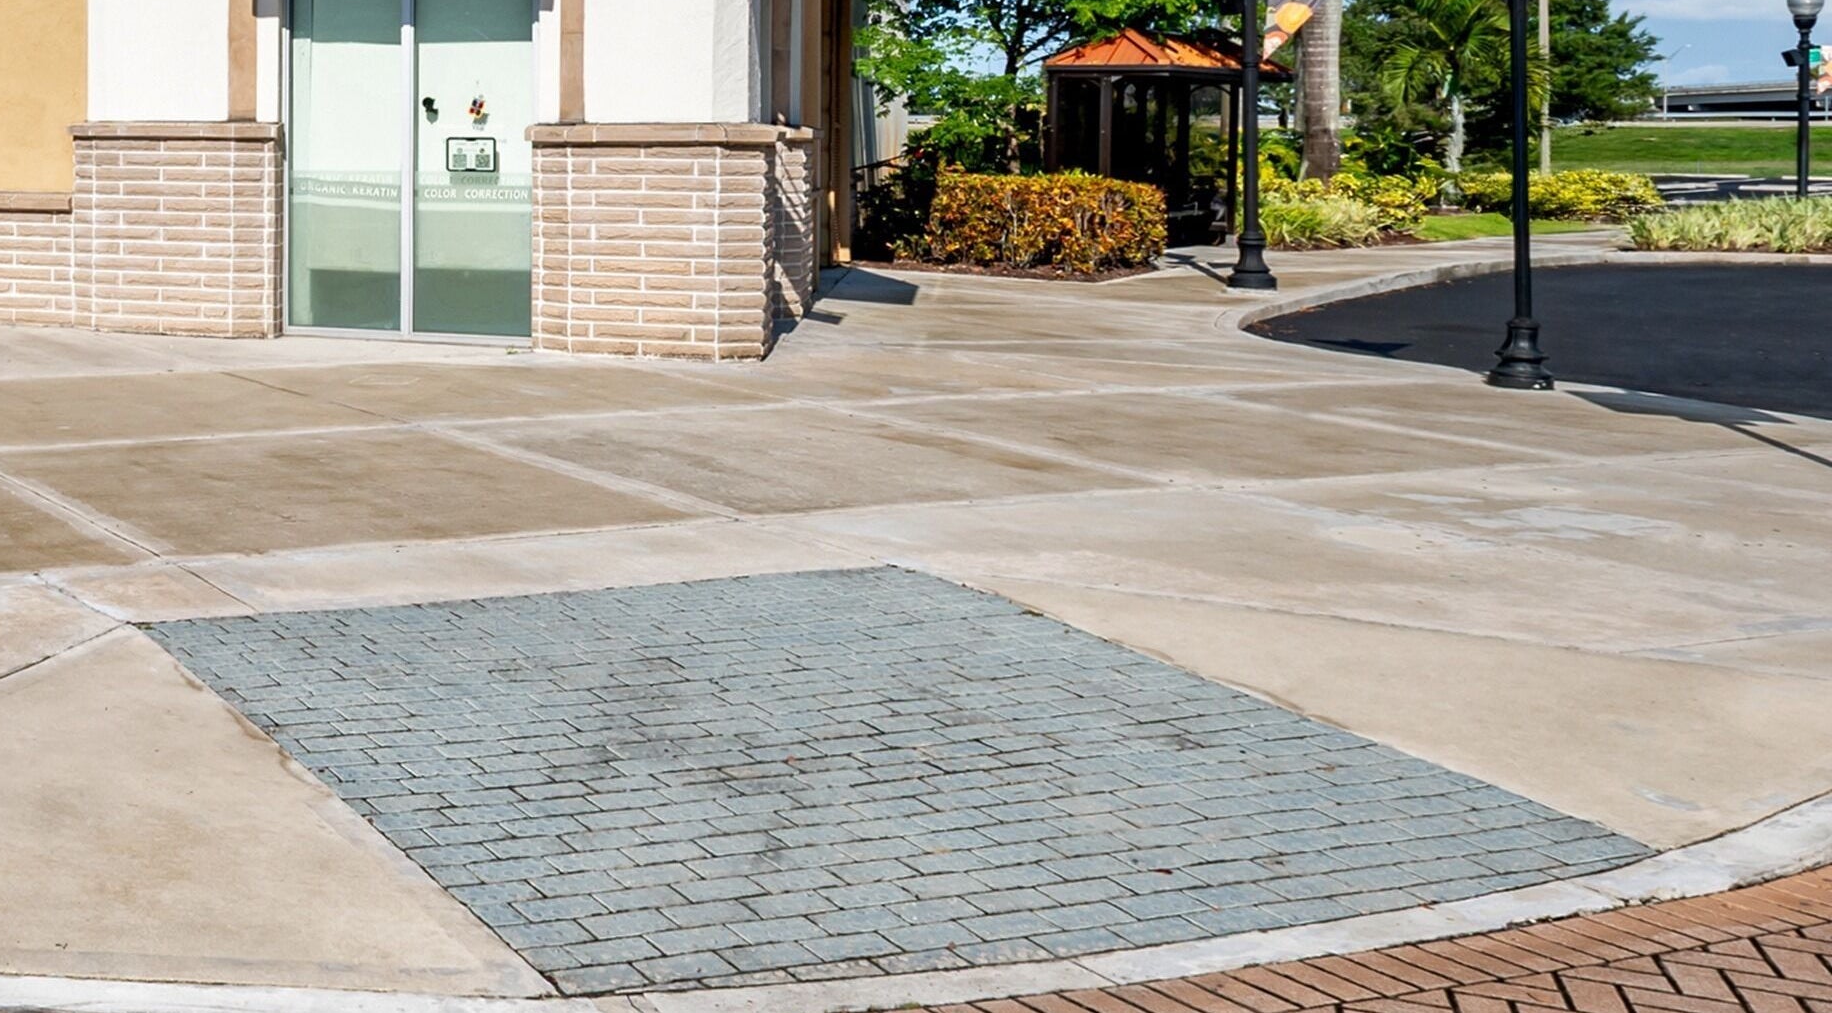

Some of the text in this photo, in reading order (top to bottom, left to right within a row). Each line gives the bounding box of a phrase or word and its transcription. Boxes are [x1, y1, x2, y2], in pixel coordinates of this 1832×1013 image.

[352, 186, 398, 198] KERATIN
[424, 188, 529, 199] COLOR CORRECTION
